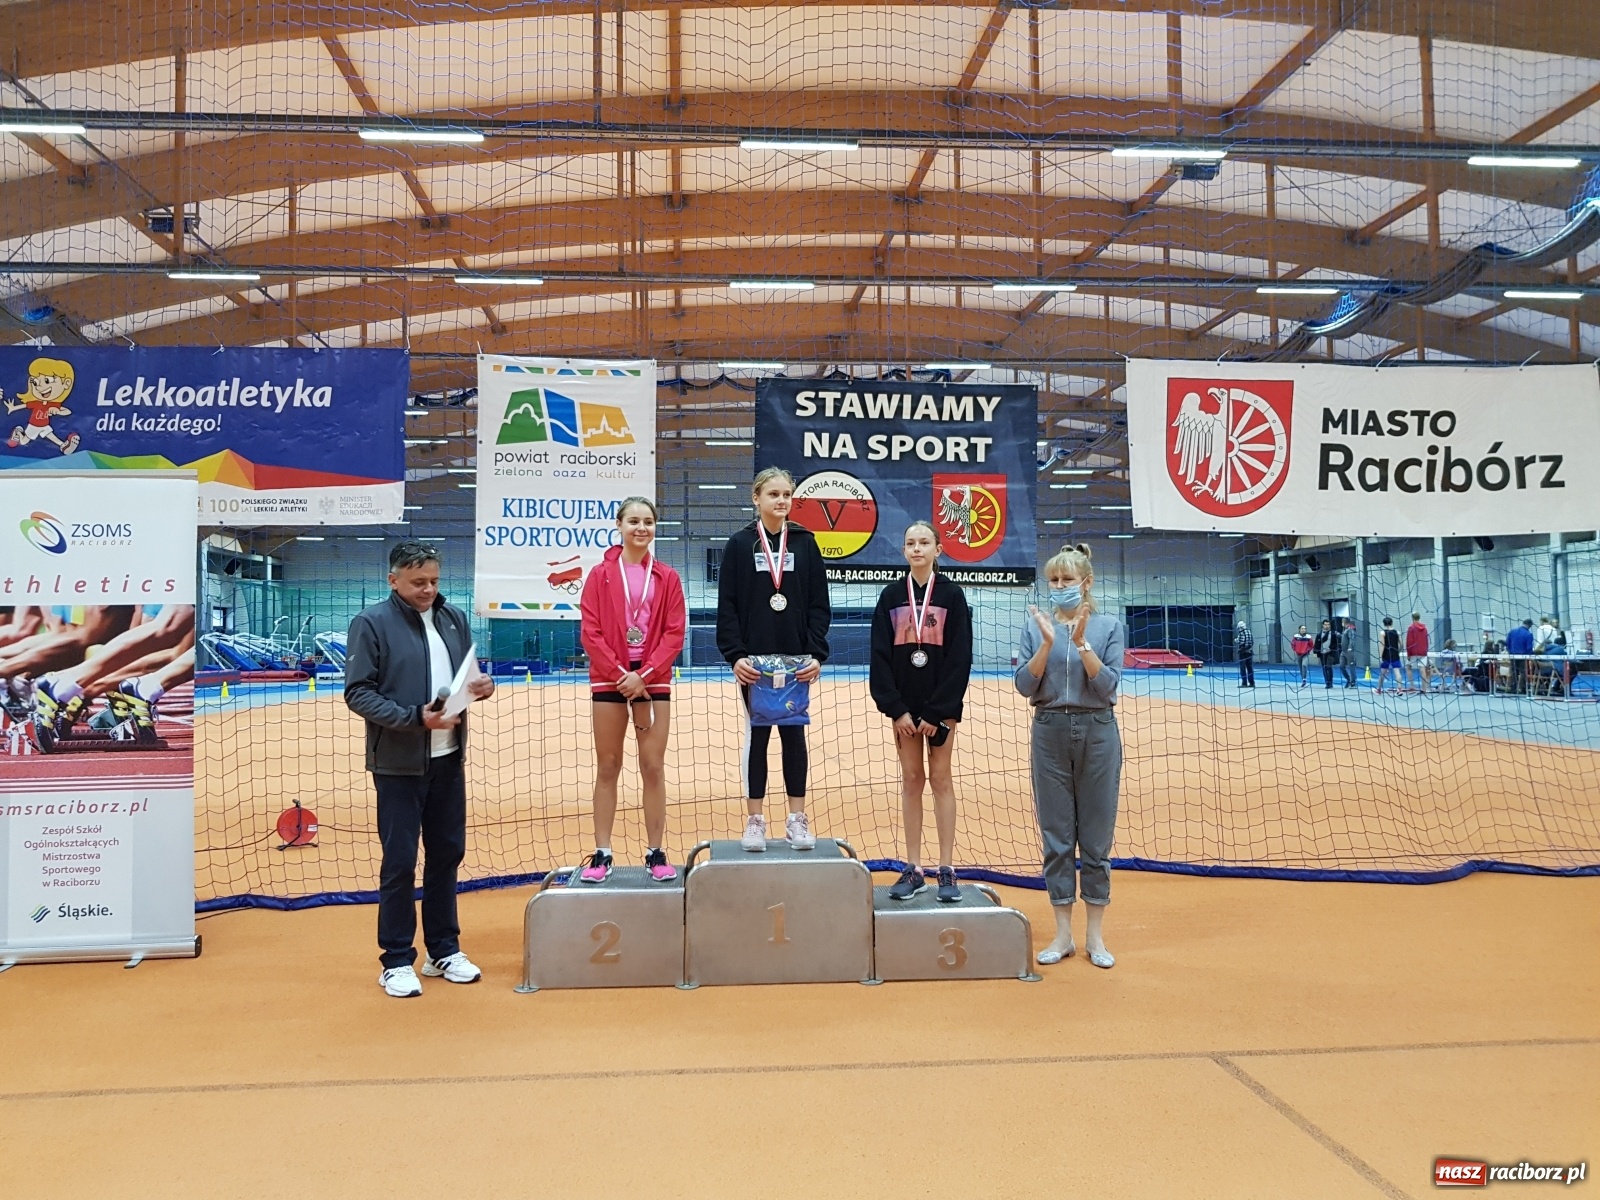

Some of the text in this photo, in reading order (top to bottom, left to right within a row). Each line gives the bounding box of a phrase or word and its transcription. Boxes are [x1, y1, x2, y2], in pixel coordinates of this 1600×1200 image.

[96, 376, 333, 413] Lekkoatletyka
[795, 391, 1001, 422] STAWIAMY
[96, 412, 222, 435] dla każdego!
[1321, 407, 1456, 437] MIASTO
[803, 432, 993, 463] NA SPORT
[494, 449, 636, 467] powiat raciborski
[1317, 441, 1566, 493] Racibórz
[494, 466, 636, 479] zielona oaza kultur
[279, 498, 308, 506] ZWIĄZKU
[796, 480, 870, 512] VICTORIA RACIBÓRZ
[210, 498, 240, 513] 100
[817, 500, 847, 530] V
[71, 523, 132, 538] ZSOMS
[821, 547, 843, 556] 1970
[4, 574, 176, 593] thletics
[42, 825, 102, 837] Zespół Szkół
[24, 838, 119, 850] Ogólnokształcących
[42, 852, 100, 861] Mistrzostwa
[42, 865, 101, 876] Sportowego
[53, 878, 100, 887] Raciborzu
[58, 903, 113, 920] Śląskie.
[767, 903, 790, 944] 1
[590, 921, 622, 964] 2
[937, 928, 968, 971] 3
